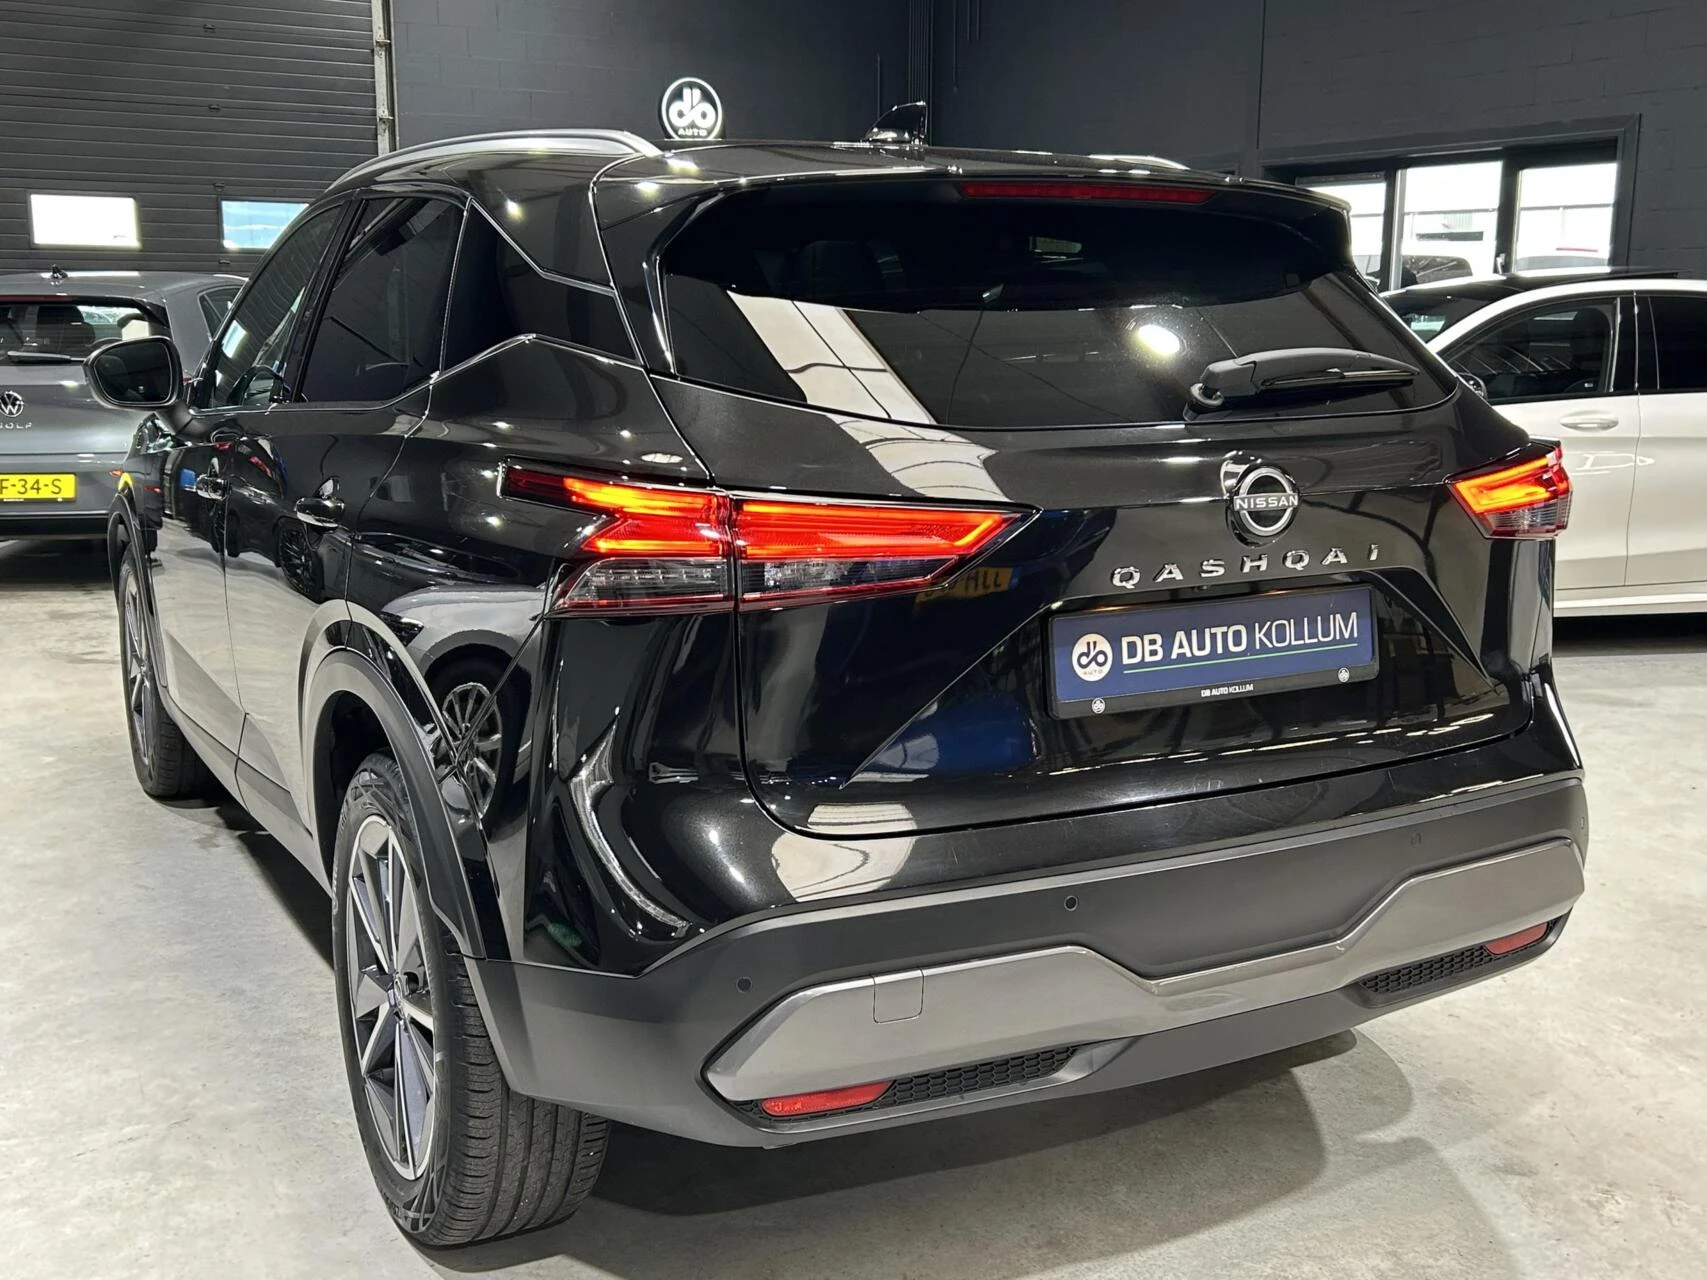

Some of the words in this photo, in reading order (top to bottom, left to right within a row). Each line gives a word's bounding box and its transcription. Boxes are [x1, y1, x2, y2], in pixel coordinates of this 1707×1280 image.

[678, 128, 707, 136] AUTO
[1235, 495, 1298, 510] NISSAN
[1111, 544, 1380, 589] QASHQAI
[1121, 633, 1163, 665] DB
[1170, 624, 1247, 660] AUTO
[1254, 611, 1358, 650] KOLLUM
[1201, 689, 1211, 697] DB
[1211, 686, 1229, 696] AUTO
[1229, 683, 1254, 693] KOLLUM
